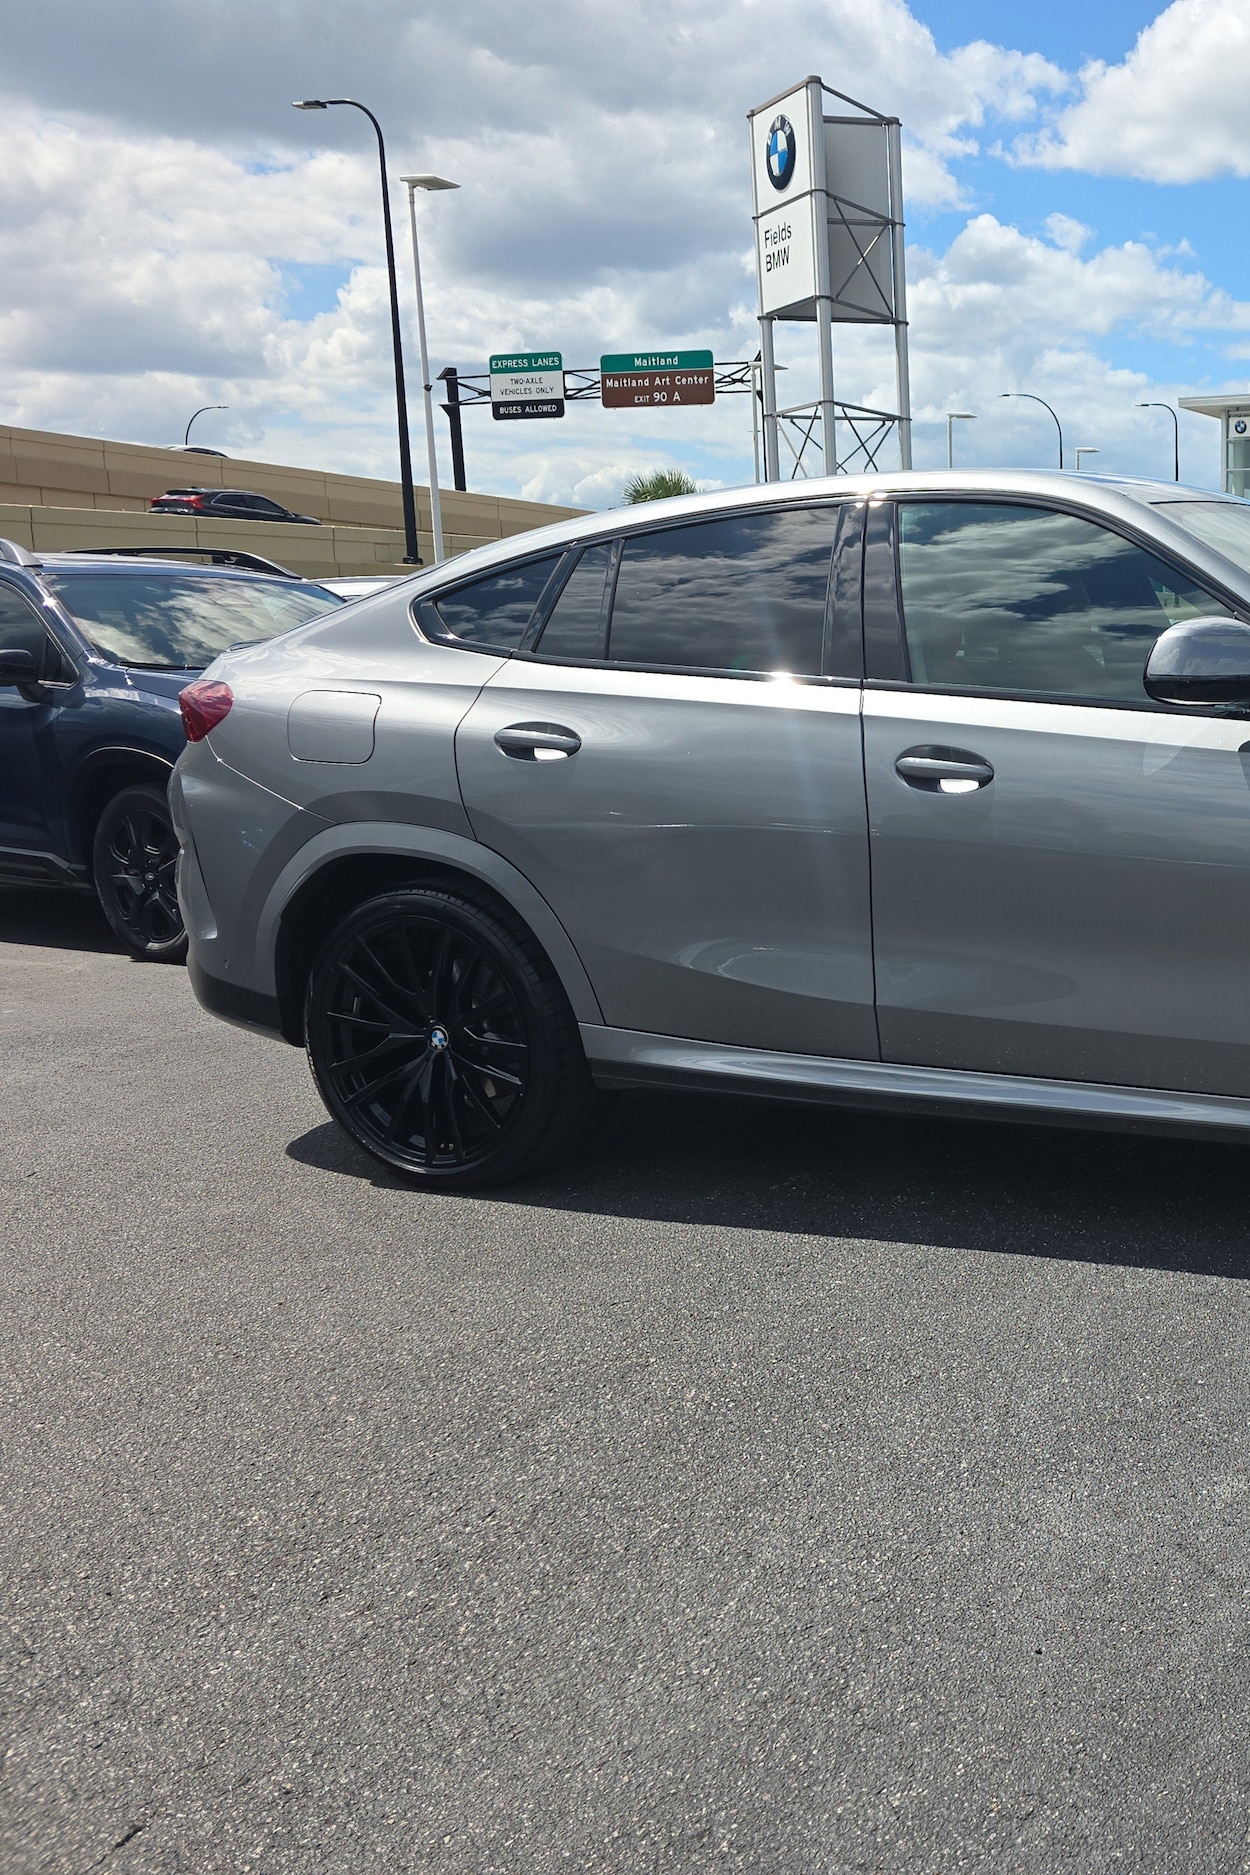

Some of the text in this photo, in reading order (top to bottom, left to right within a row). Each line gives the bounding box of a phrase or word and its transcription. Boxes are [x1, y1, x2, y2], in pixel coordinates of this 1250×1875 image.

[764, 222, 792, 248] Fields
[766, 246, 790, 273] BMW
[492, 357, 560, 369] EXPRESS LANES
[634, 356, 679, 367] Maitland
[510, 377, 543, 386] TWO-AXLE
[606, 374, 709, 388] Maitland Art Center
[500, 386, 555, 396] VEHICLES ONLY
[634, 391, 681, 403] EXIT 90 A
[499, 404, 557, 414] BUSES ALLOWED
